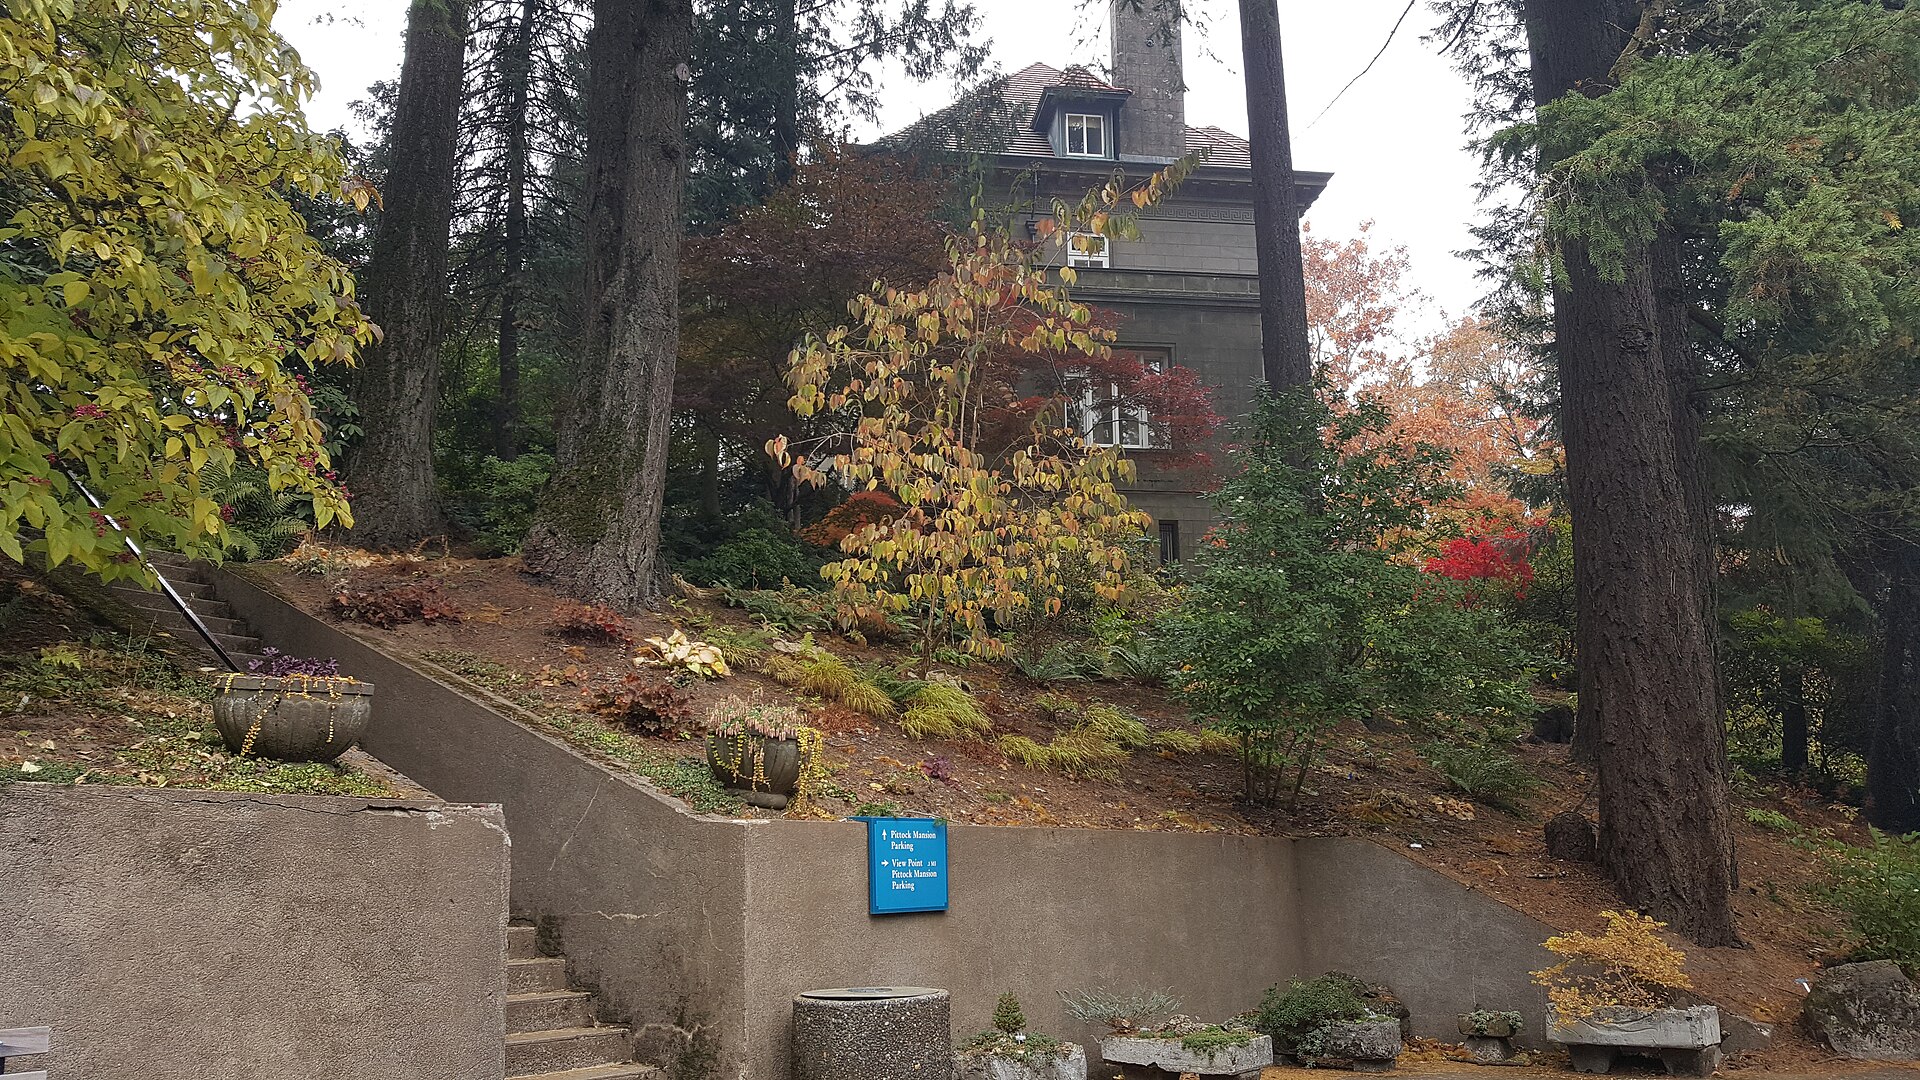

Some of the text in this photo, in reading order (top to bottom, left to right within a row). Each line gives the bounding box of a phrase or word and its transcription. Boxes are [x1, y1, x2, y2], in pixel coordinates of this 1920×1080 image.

[891, 830, 936, 839] Pittock Mansion
[891, 842, 914, 852] Parking
[892, 859, 906, 867] View
[908, 859, 922, 867] Point
[892, 870, 937, 878] Pittock Mansion
[892, 881, 914, 891] Parking
